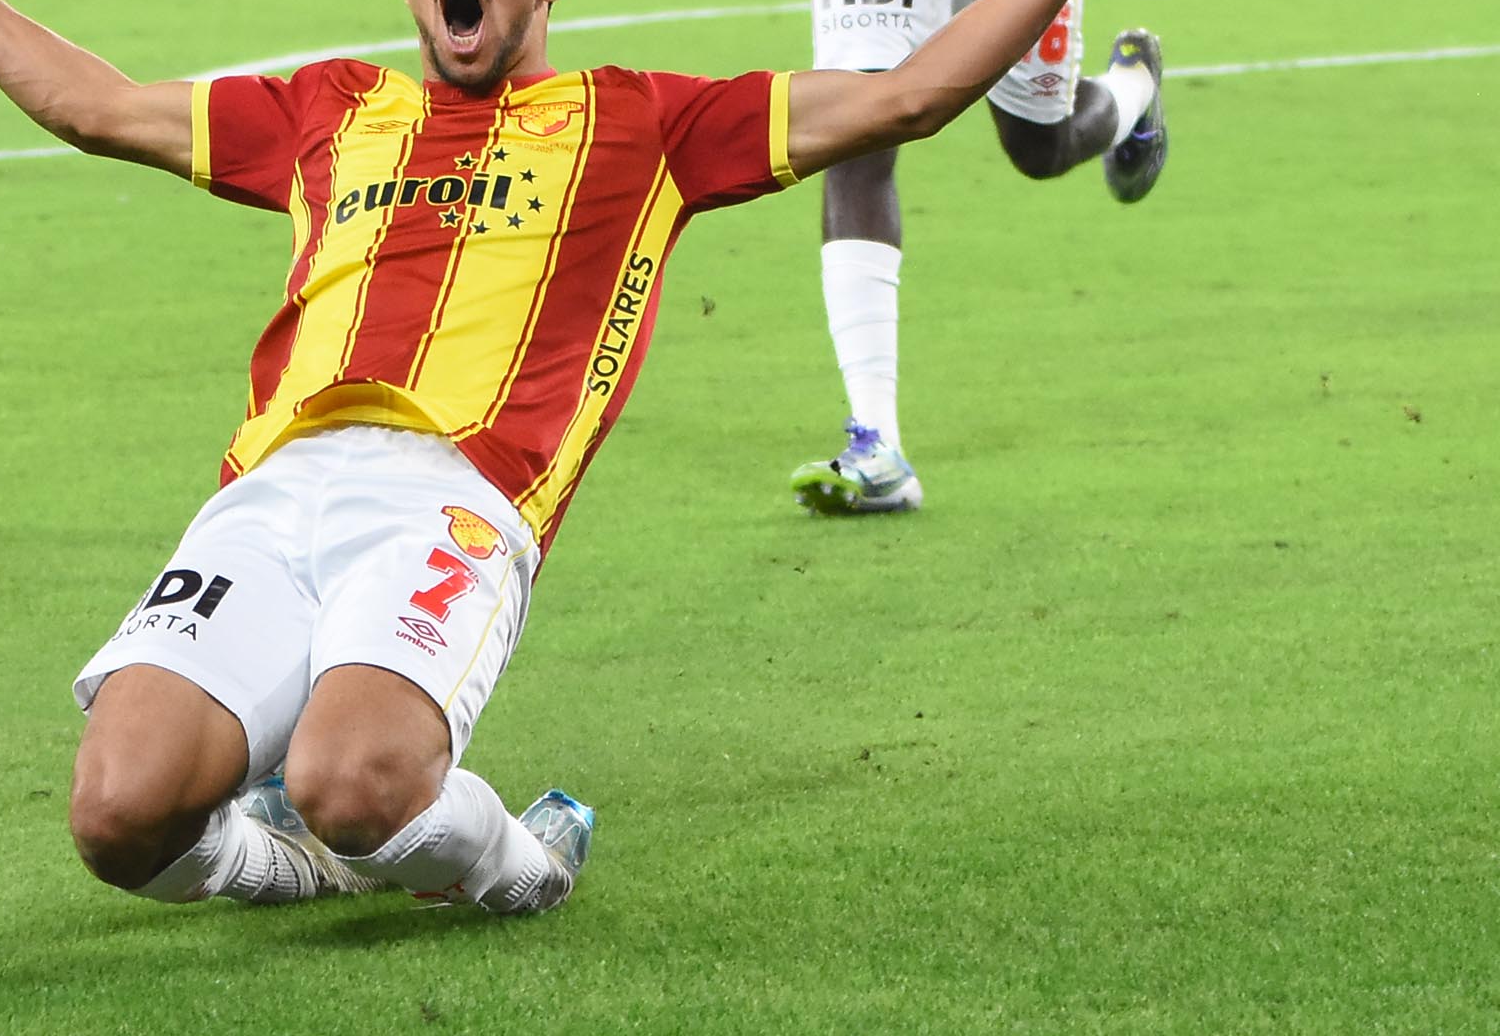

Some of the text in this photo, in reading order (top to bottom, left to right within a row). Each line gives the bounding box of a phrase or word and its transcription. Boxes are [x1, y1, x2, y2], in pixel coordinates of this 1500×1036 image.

[335, 172, 512, 224] euroil
[587, 251, 654, 396] SOLARES
[130, 569, 233, 620] DI
[409, 547, 478, 624] 7
[395, 630, 436, 657] umbro
